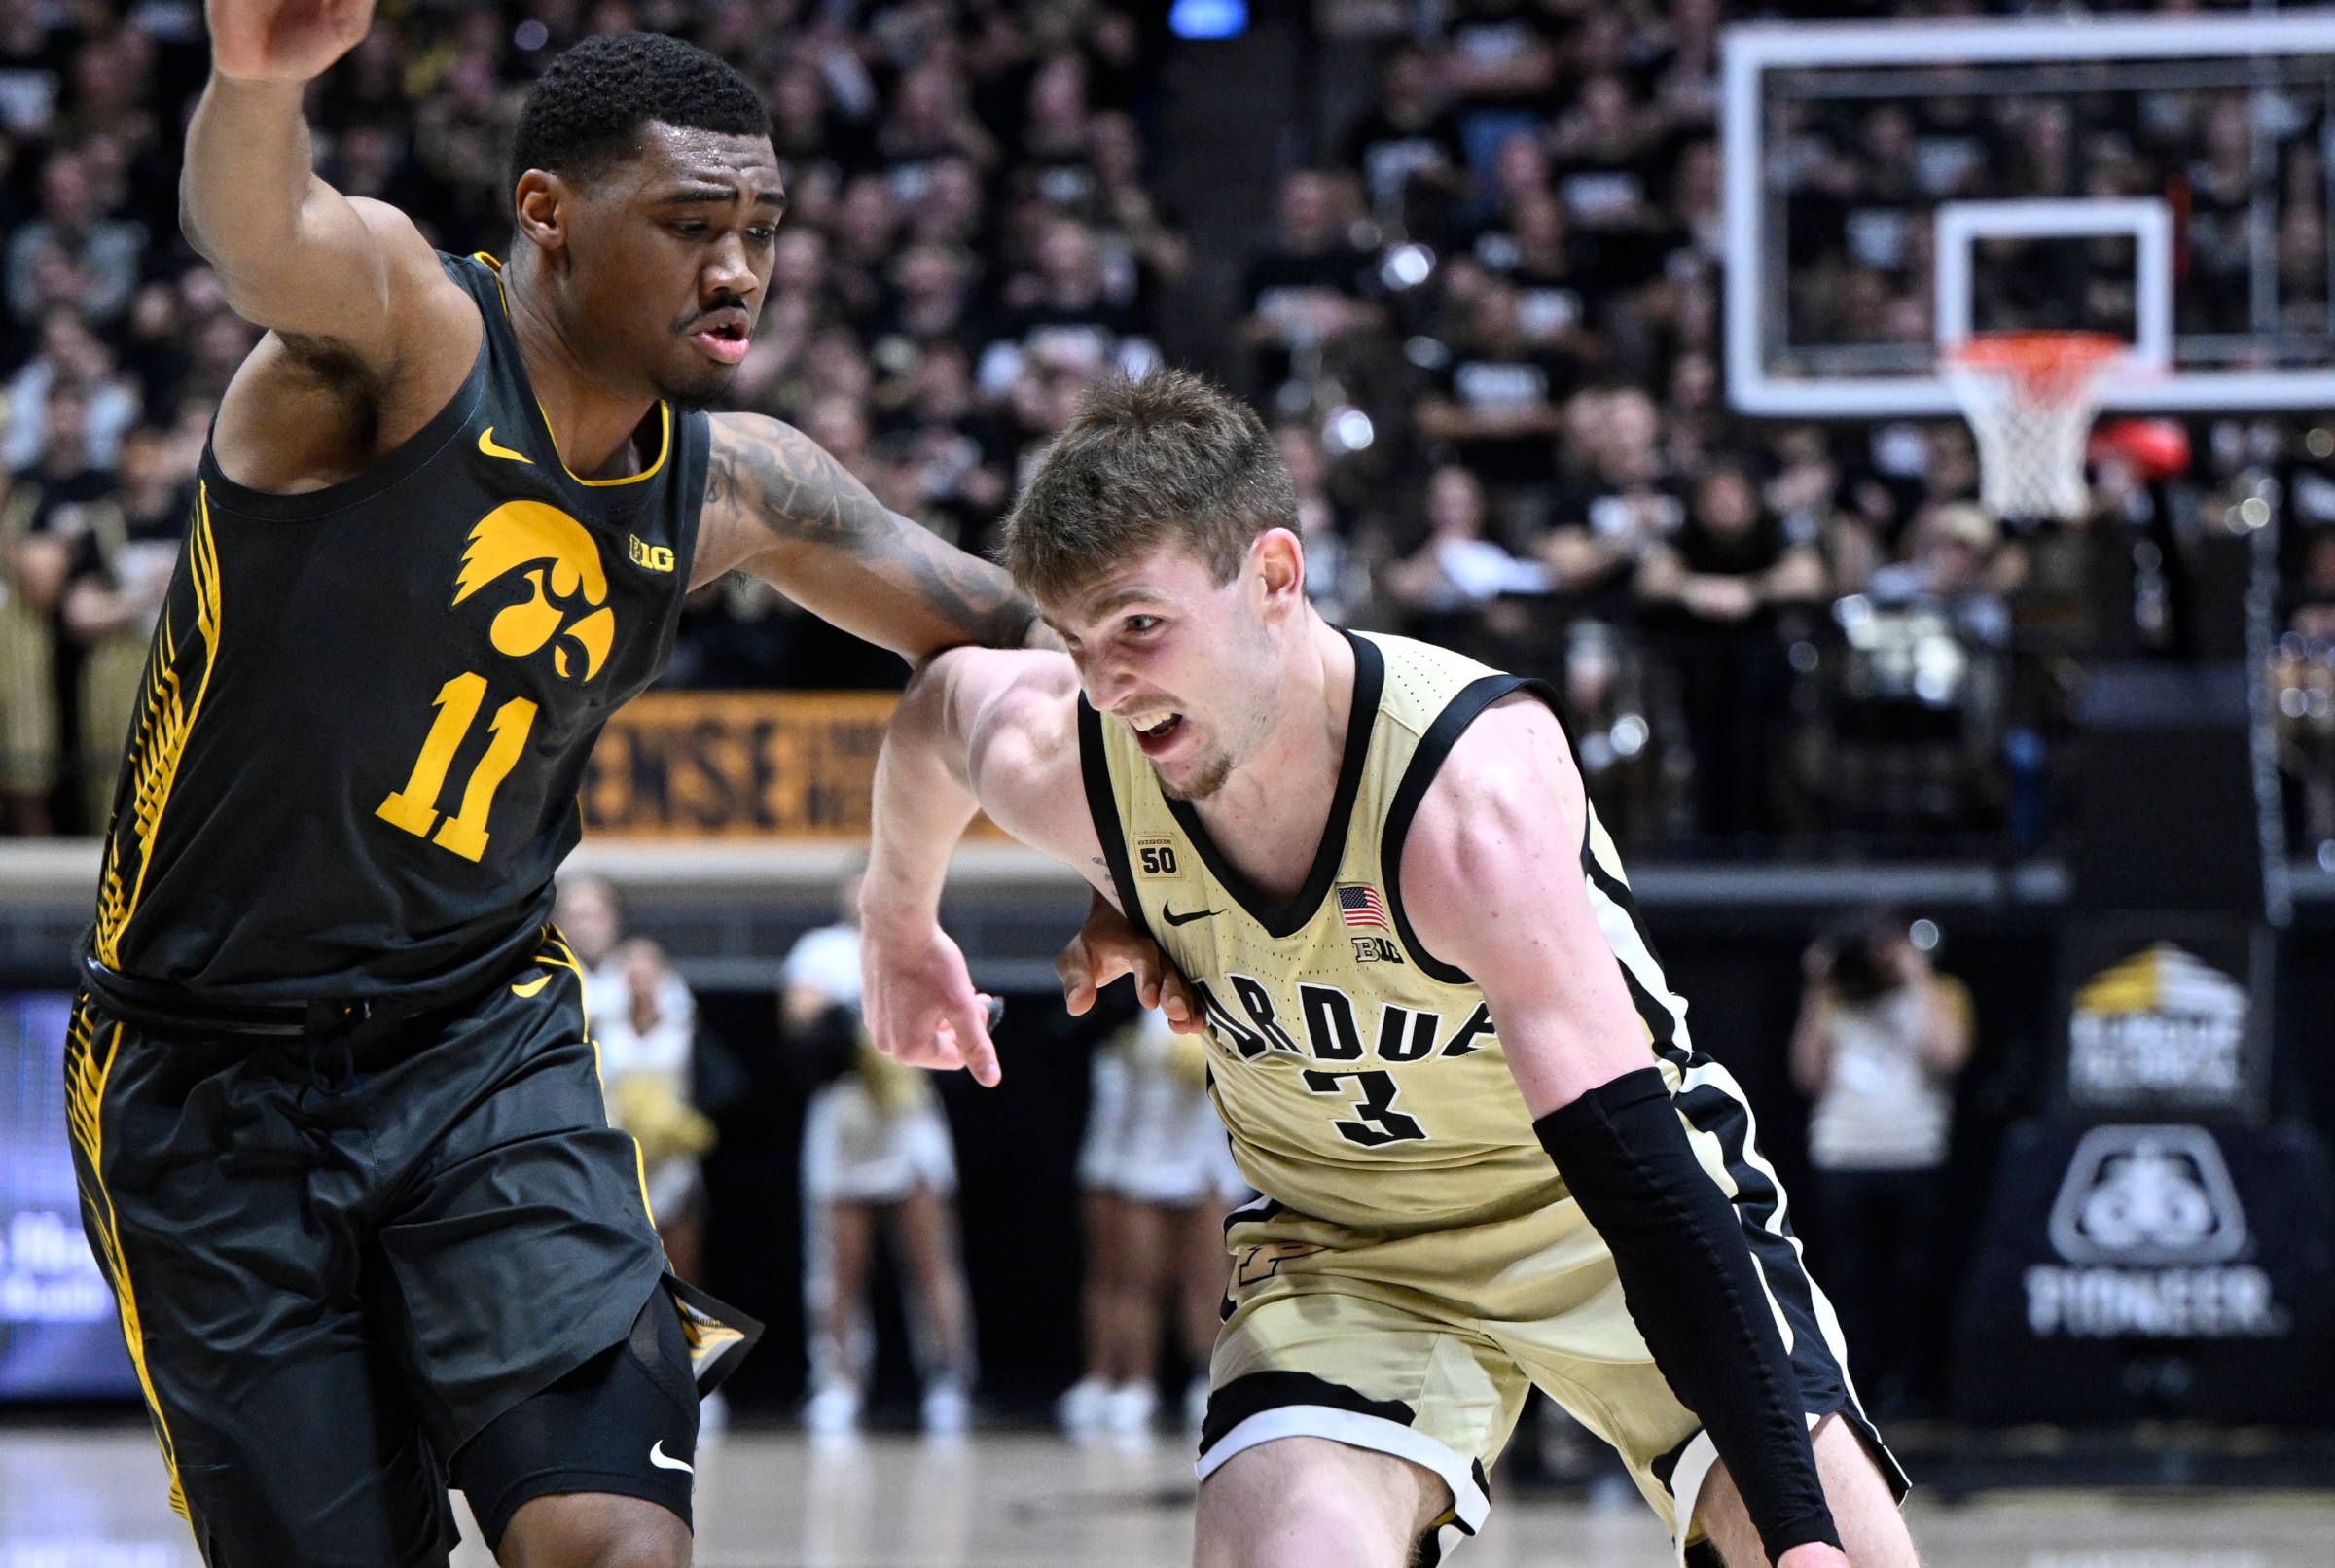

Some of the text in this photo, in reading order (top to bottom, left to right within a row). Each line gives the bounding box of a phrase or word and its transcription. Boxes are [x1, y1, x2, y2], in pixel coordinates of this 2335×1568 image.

[375, 671, 538, 863] 11
[1139, 846, 1177, 874] 50
[1191, 972, 1498, 1063] URDUE
[1299, 1069, 1430, 1149] 3
